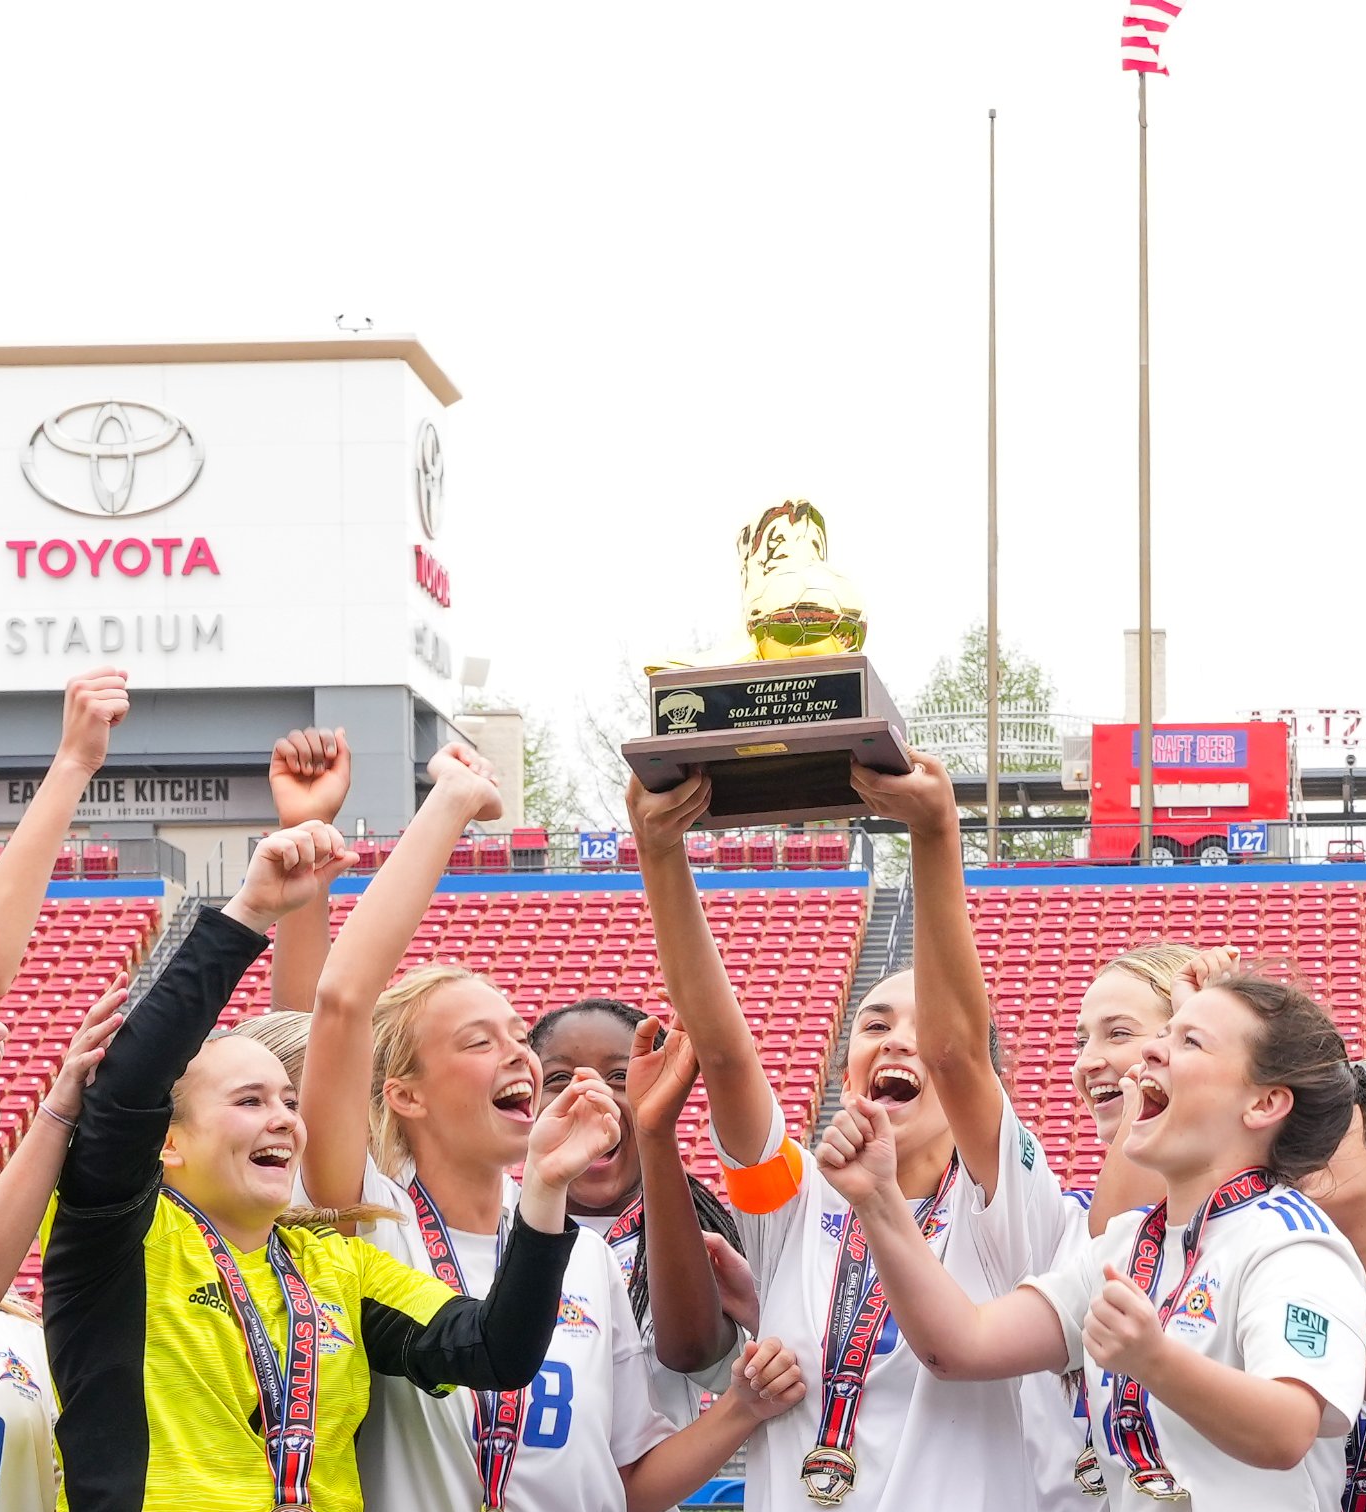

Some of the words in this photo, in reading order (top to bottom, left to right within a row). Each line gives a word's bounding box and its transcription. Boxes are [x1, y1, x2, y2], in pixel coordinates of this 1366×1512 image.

[5, 536, 221, 579] TOYOTA
[5, 612, 225, 657] STADIUM
[747, 678, 817, 695] CHAMPION
[755, 693, 788, 704] GIRLS
[792, 691, 810, 702] 17U
[728, 706, 768, 719] SOLAR
[773, 703, 802, 715] U17G
[806, 700, 839, 712] ECNL
[734, 718, 772, 729] PRESENTED
[788, 714, 813, 724] MARY
[815, 711, 833, 722] KAY
[1151, 735, 1194, 763] RAFT
[1196, 735, 1235, 763] BEER
[134, 777, 230, 803] KITCHEN
[581, 840, 616, 859] 128
[1231, 831, 1264, 851] 127
[1214, 1175, 1267, 1209] DALL
[408, 1186, 448, 1258] DALLAS
[435, 1261, 463, 1295] CU
[214, 1253, 247, 1302] CUP
[286, 1273, 312, 1316] CUP
[1288, 1306, 1329, 1336] ECNL
[259, 1343, 282, 1408] INVITATIONAL
[290, 1322, 314, 1420] DALLAS
[523, 1360, 574, 1449] 8
